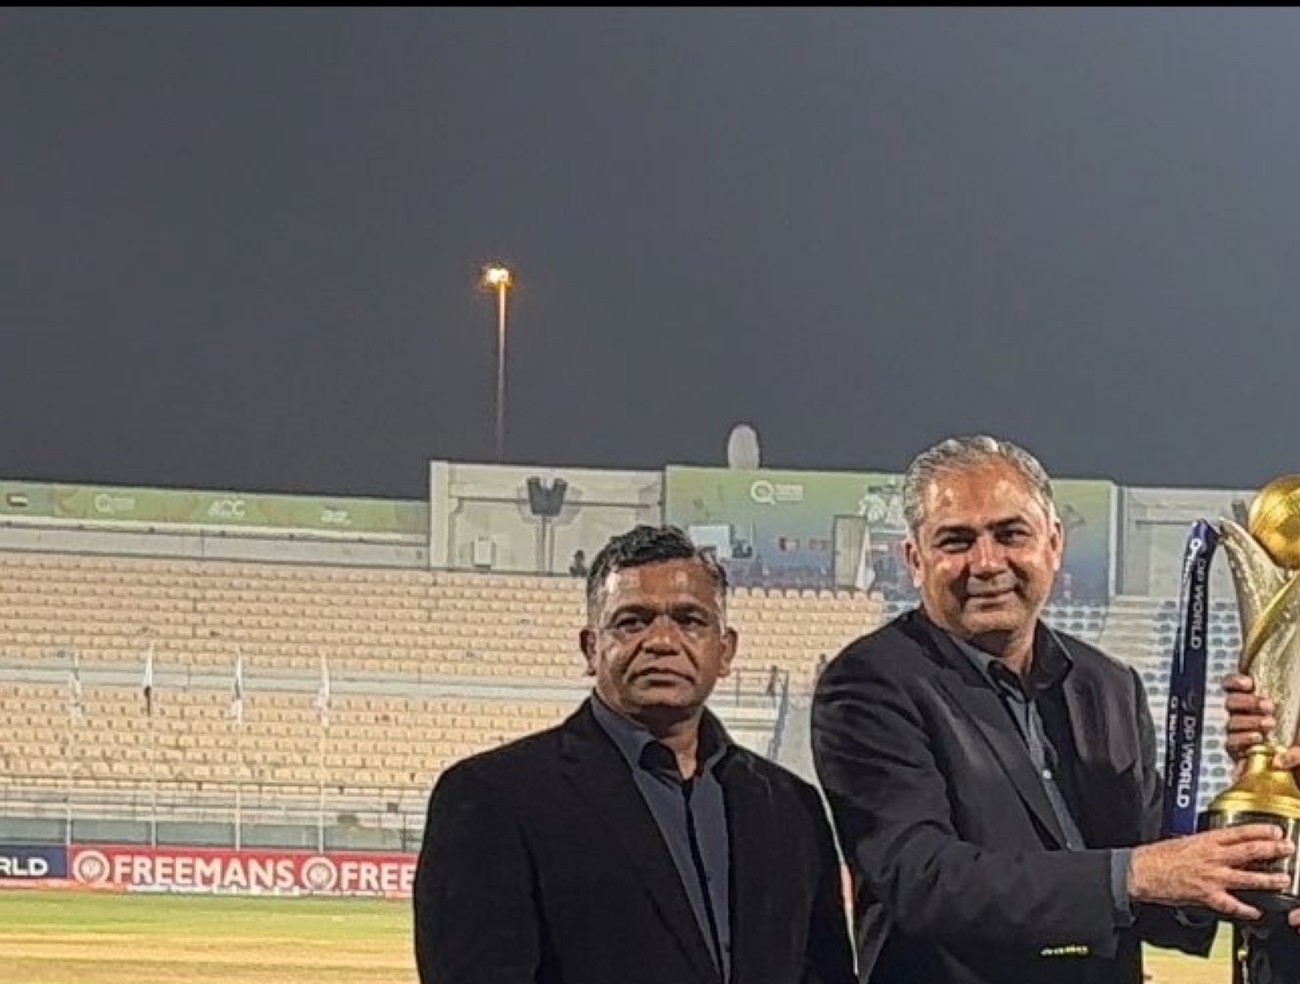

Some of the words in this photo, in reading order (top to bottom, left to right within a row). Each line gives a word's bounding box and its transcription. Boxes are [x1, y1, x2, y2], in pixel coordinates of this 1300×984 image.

[1191, 584, 1205, 650] WORLD
[1183, 715, 1197, 741] DP
[1177, 742, 1195, 808] WORLD
[114, 855, 295, 889] FREEMANS
